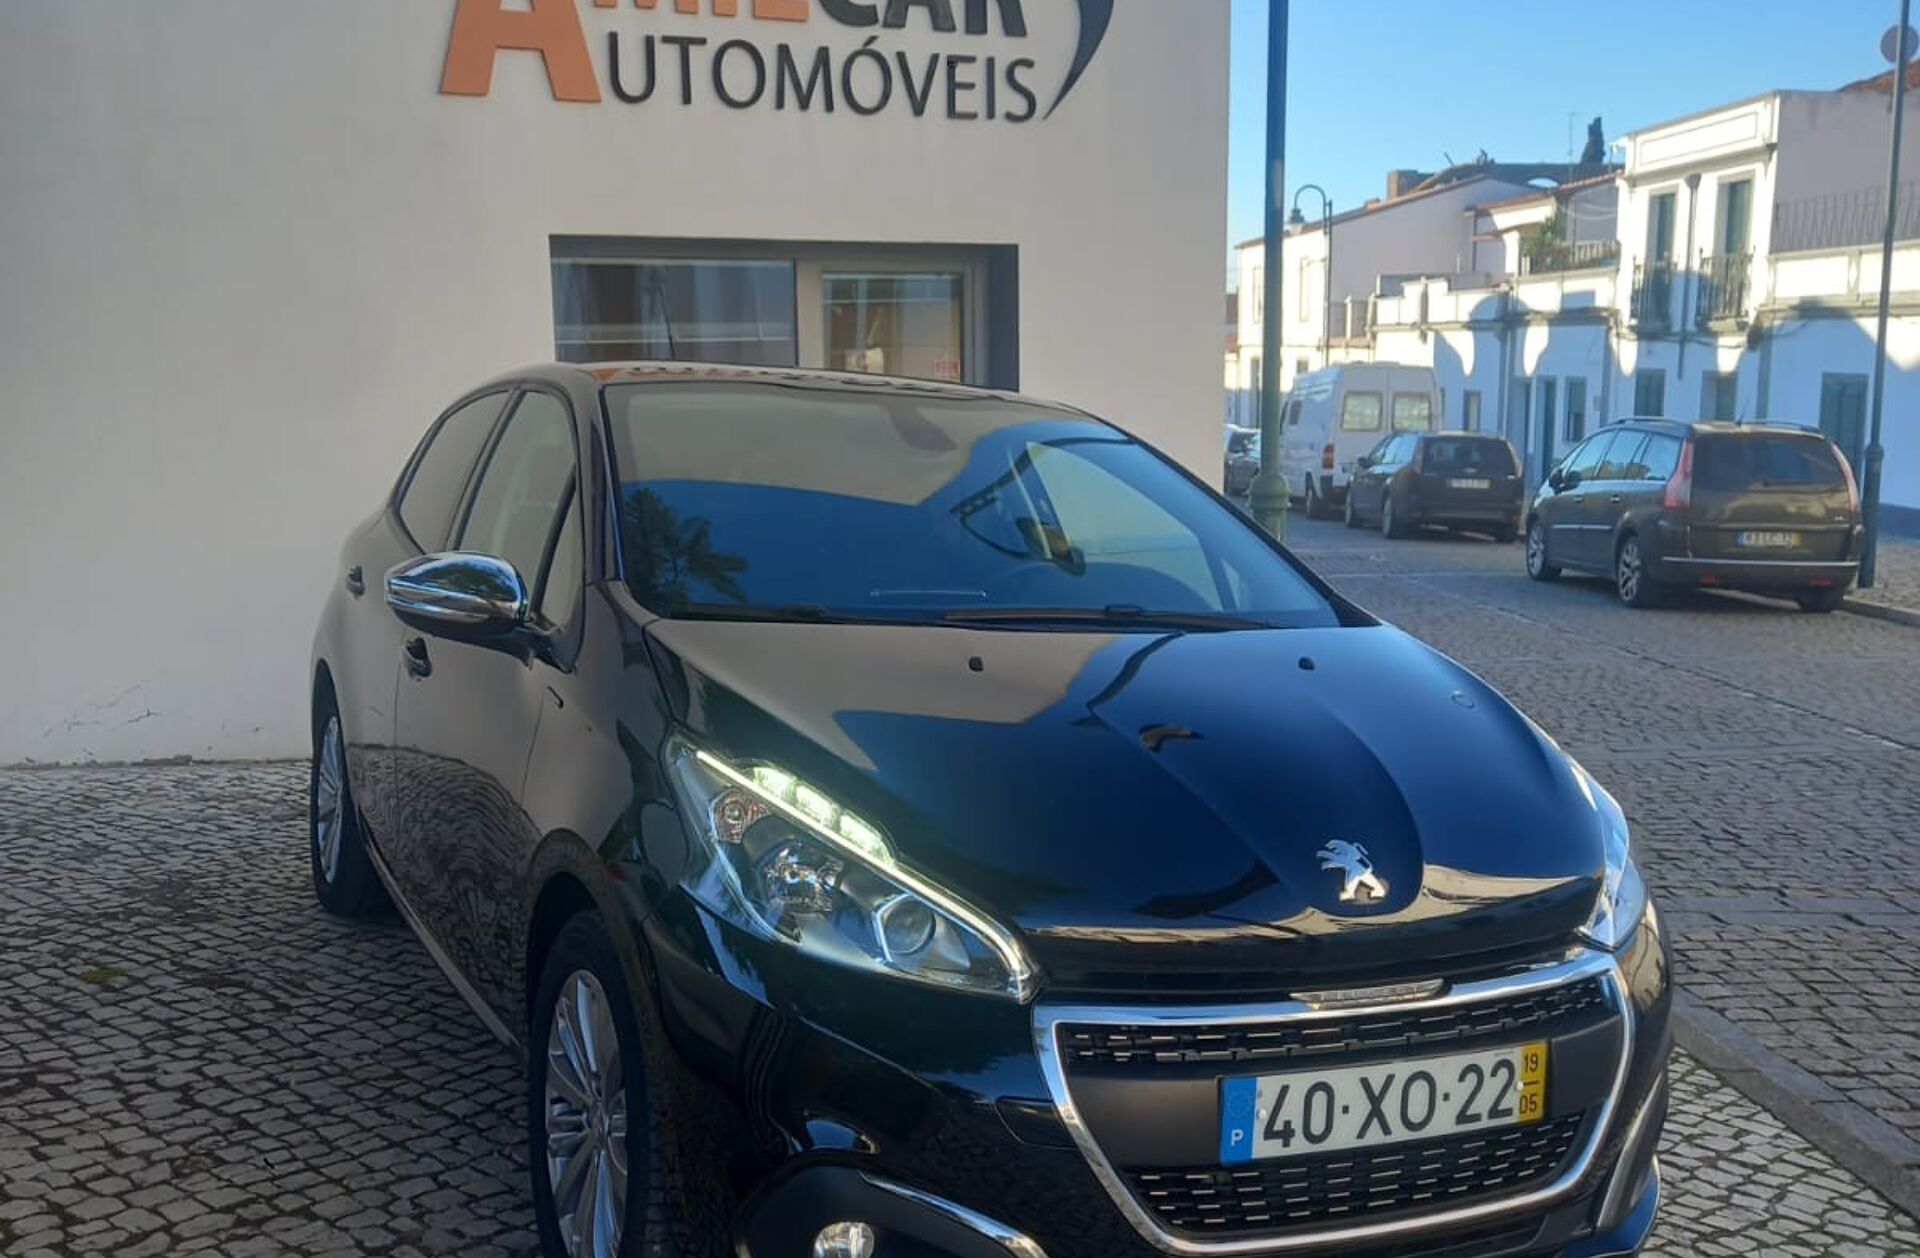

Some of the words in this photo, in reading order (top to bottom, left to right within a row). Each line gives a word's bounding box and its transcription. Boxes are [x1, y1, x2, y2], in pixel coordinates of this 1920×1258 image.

[1524, 1053, 1539, 1073] 19
[1518, 1095, 1538, 1115] 05
[1230, 1129, 1244, 1147] P
